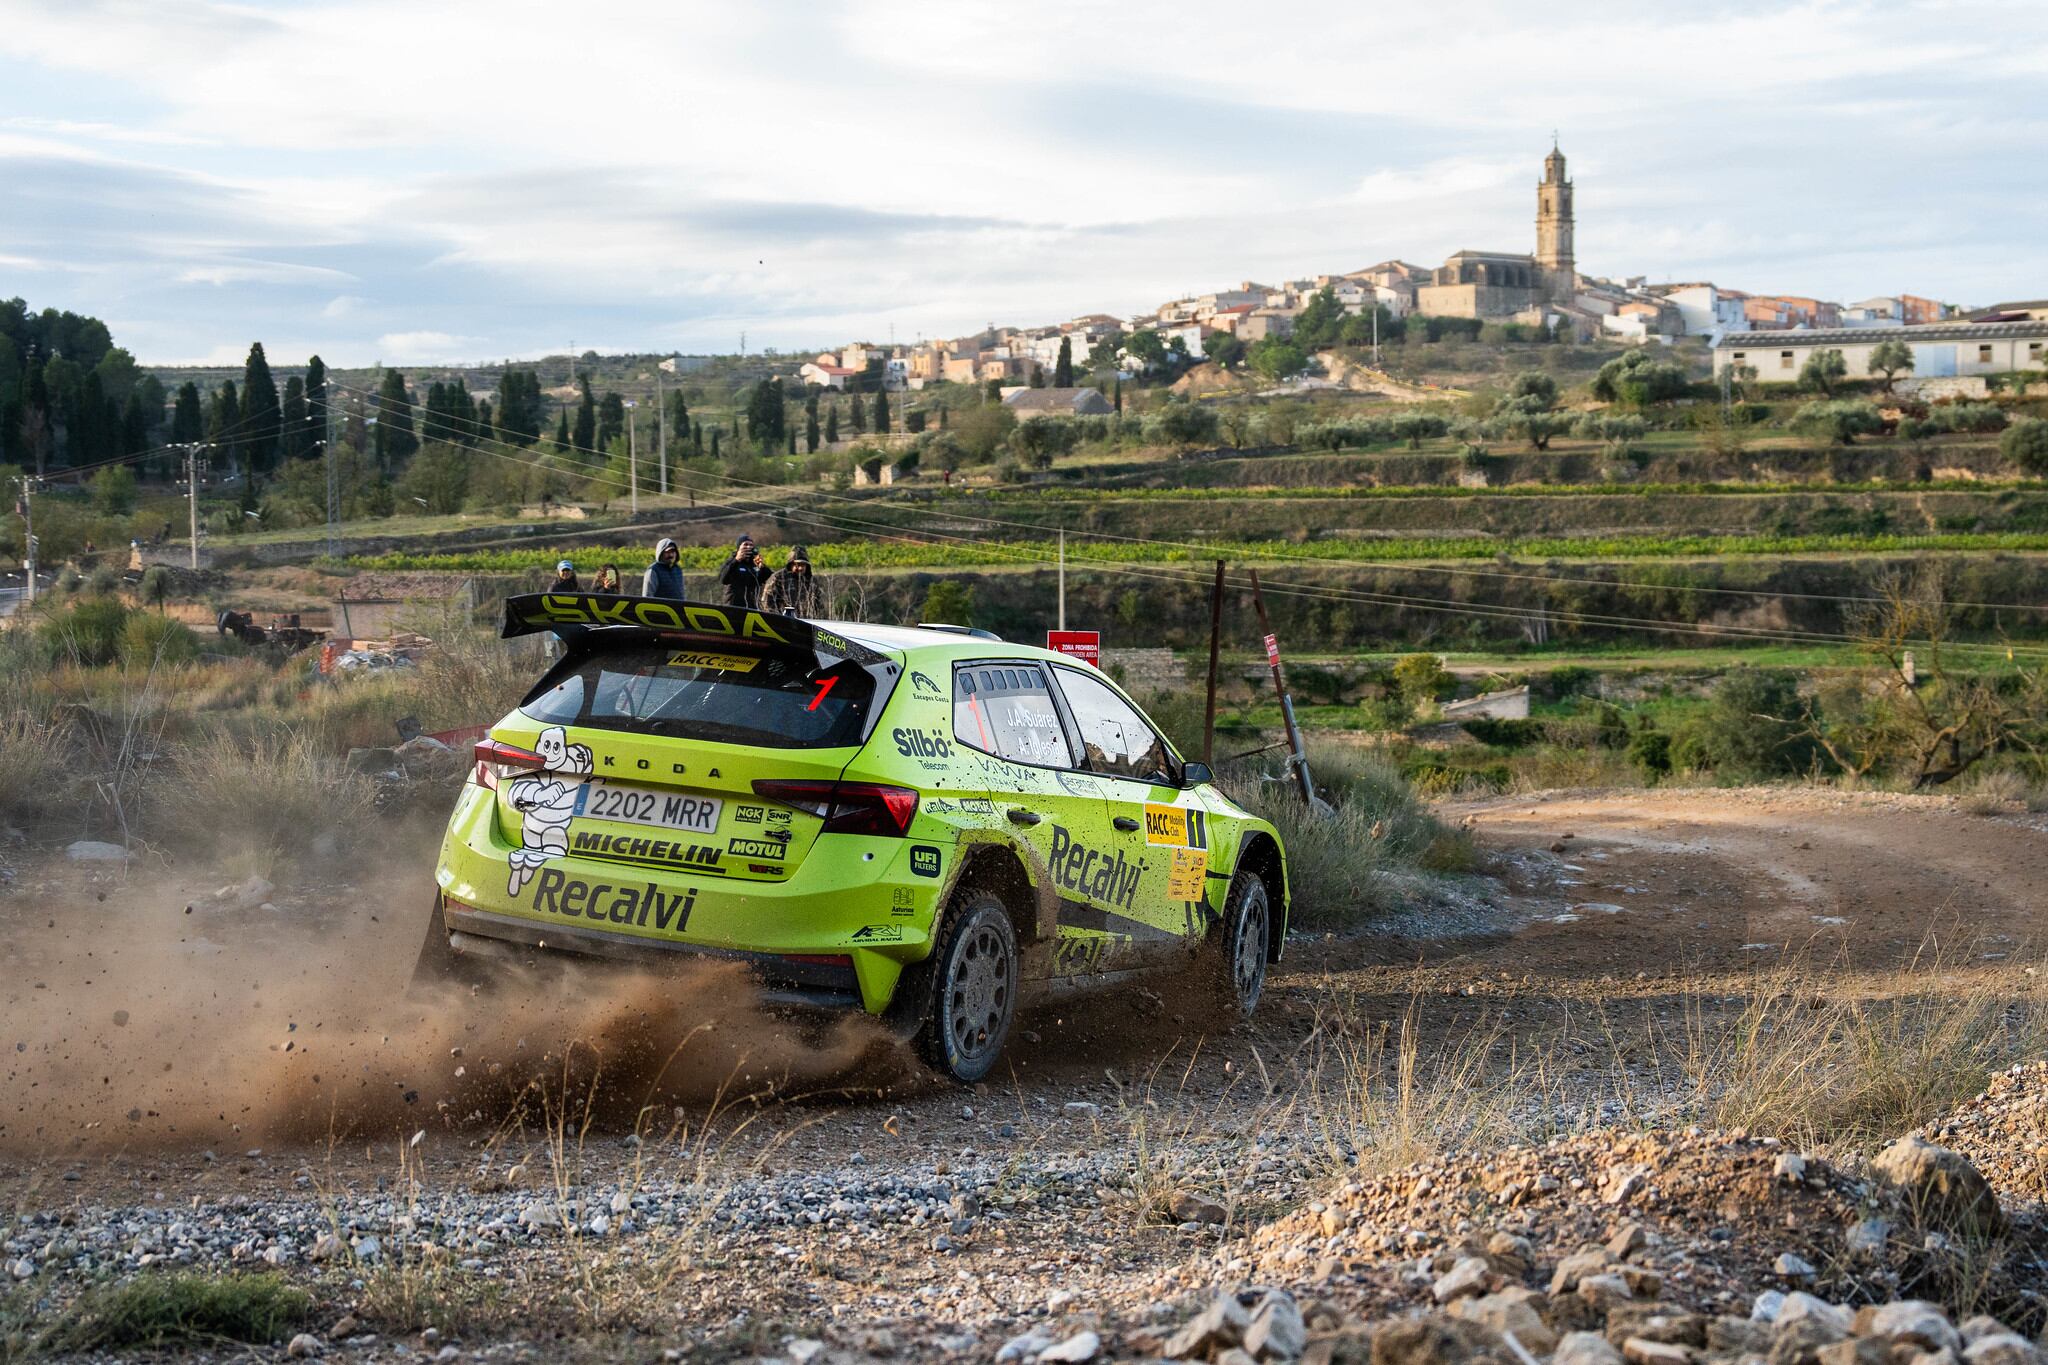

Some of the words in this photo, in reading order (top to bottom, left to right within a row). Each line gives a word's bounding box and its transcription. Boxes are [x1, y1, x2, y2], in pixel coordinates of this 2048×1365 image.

[674, 654, 720, 666] RACC
[721, 657, 754, 666] Mobility
[718, 661, 735, 669] Club
[808, 675, 839, 711] 1
[968, 692, 988, 752] 1
[1025, 709, 1058, 728] Suárez
[1018, 737, 1028, 756] A.
[918, 760, 950, 771] Telecom
[590, 789, 655, 821] 2202
[662, 797, 715, 828] MRR
[737, 807, 762, 819] NGK
[769, 812, 791, 820] SNR
[1146, 812, 1169, 836] RACC
[1169, 815, 1185, 828] Mobility
[1191, 810, 1200, 847] 1
[574, 832, 723, 865] MICHELIN
[731, 840, 783, 858] MOTUL
[914, 851, 937, 865] UFI
[914, 862, 937, 872] FILTERS
[1048, 823, 1145, 910] Recalvi
[532, 867, 698, 932] Recalvi
